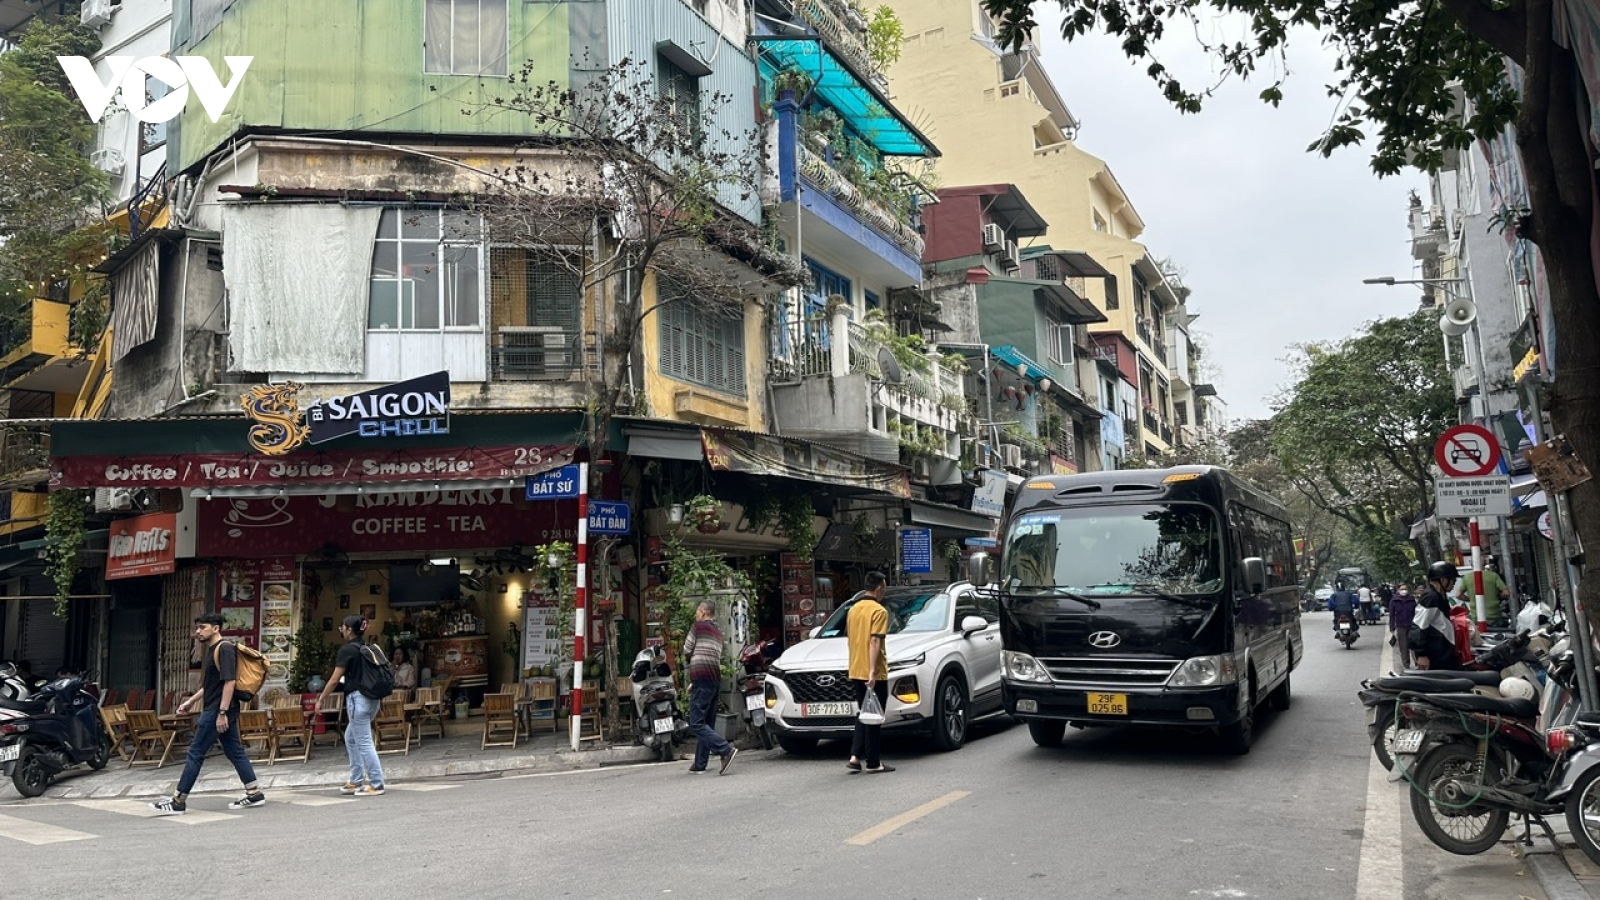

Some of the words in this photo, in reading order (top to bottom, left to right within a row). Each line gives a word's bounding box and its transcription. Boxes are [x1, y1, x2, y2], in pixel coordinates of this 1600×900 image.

[329, 391, 446, 420] SAIGON
[359, 418, 449, 437] CHILL
[514, 447, 541, 465] 28
[105, 463, 177, 481] Coffee
[200, 462, 240, 480] Tea
[269, 460, 334, 477] Juice
[363, 457, 469, 476] Smoothie
[544, 468, 562, 480] PHỐ
[533, 480, 554, 494] BÁT
[556, 478, 574, 493] SỨ
[600, 504, 616, 514] PHỐ
[352, 517, 427, 535] COFFEE
[447, 515, 486, 532] TEA
[589, 514, 606, 528] BÁT
[608, 515, 626, 529] ĐÀN
[1098, 694, 1115, 703] 29F
